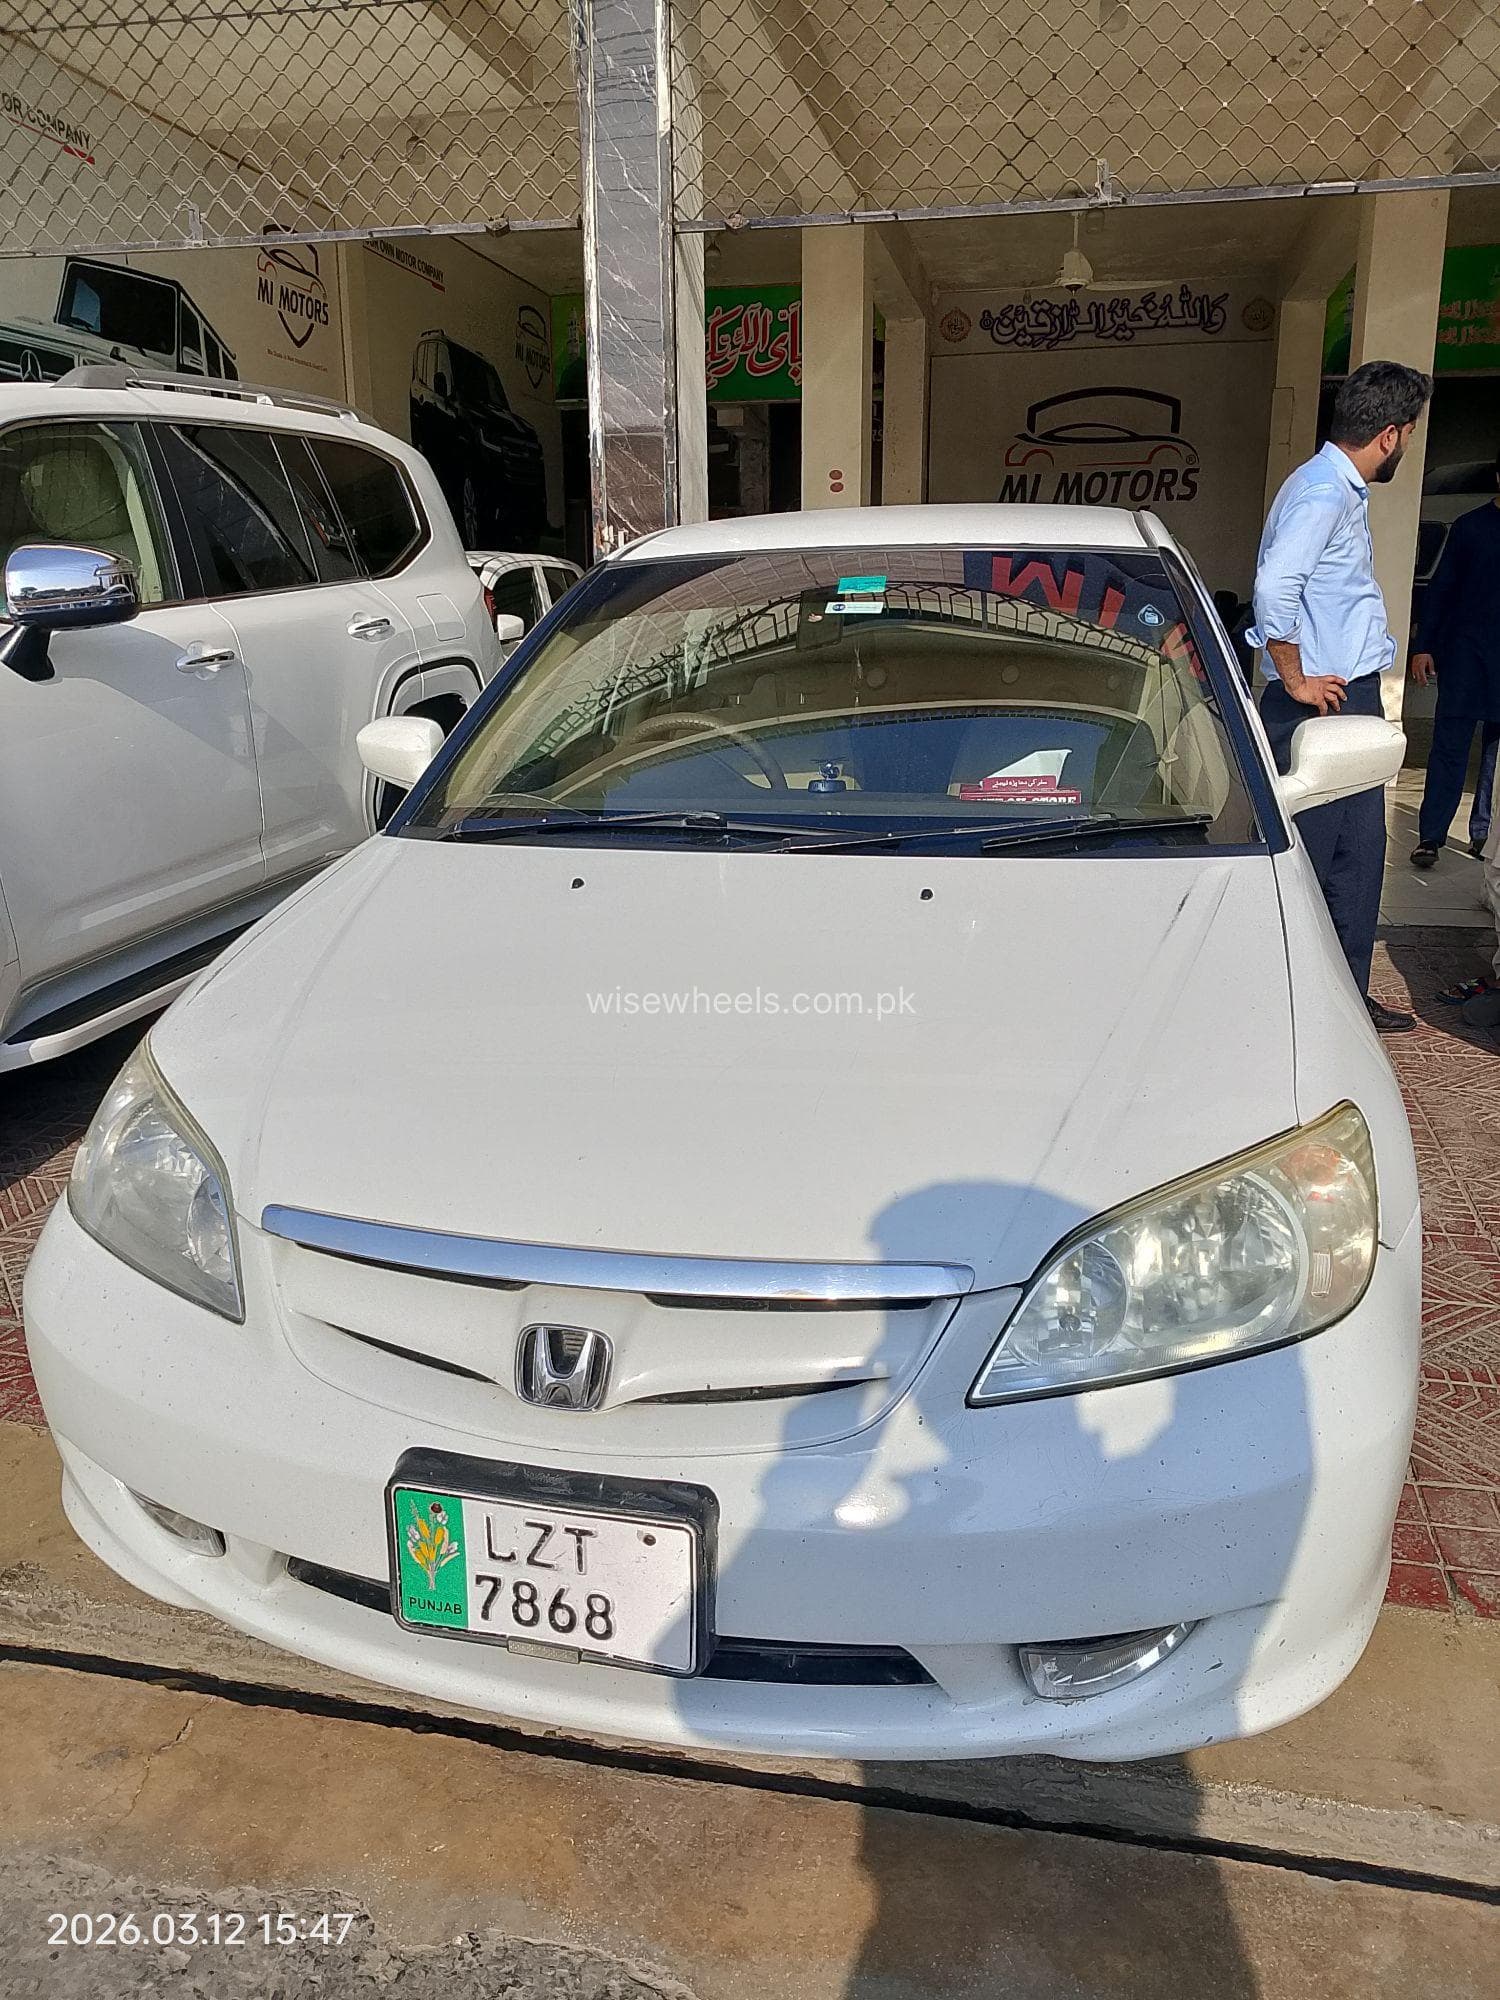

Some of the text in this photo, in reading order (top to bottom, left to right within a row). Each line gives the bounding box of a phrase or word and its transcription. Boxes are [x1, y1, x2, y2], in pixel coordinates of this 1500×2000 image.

[27, 106, 91, 149] COMPANY
[396, 247, 417, 269] MOTOR
[418, 259, 444, 283] COMPANY
[258, 277, 328, 326] MI MOTORS
[998, 467, 1200, 504] MI MOTORS
[485, 1514, 597, 1575] LZT
[409, 1596, 462, 1616] PUNJAB
[475, 1574, 615, 1641] 7868
